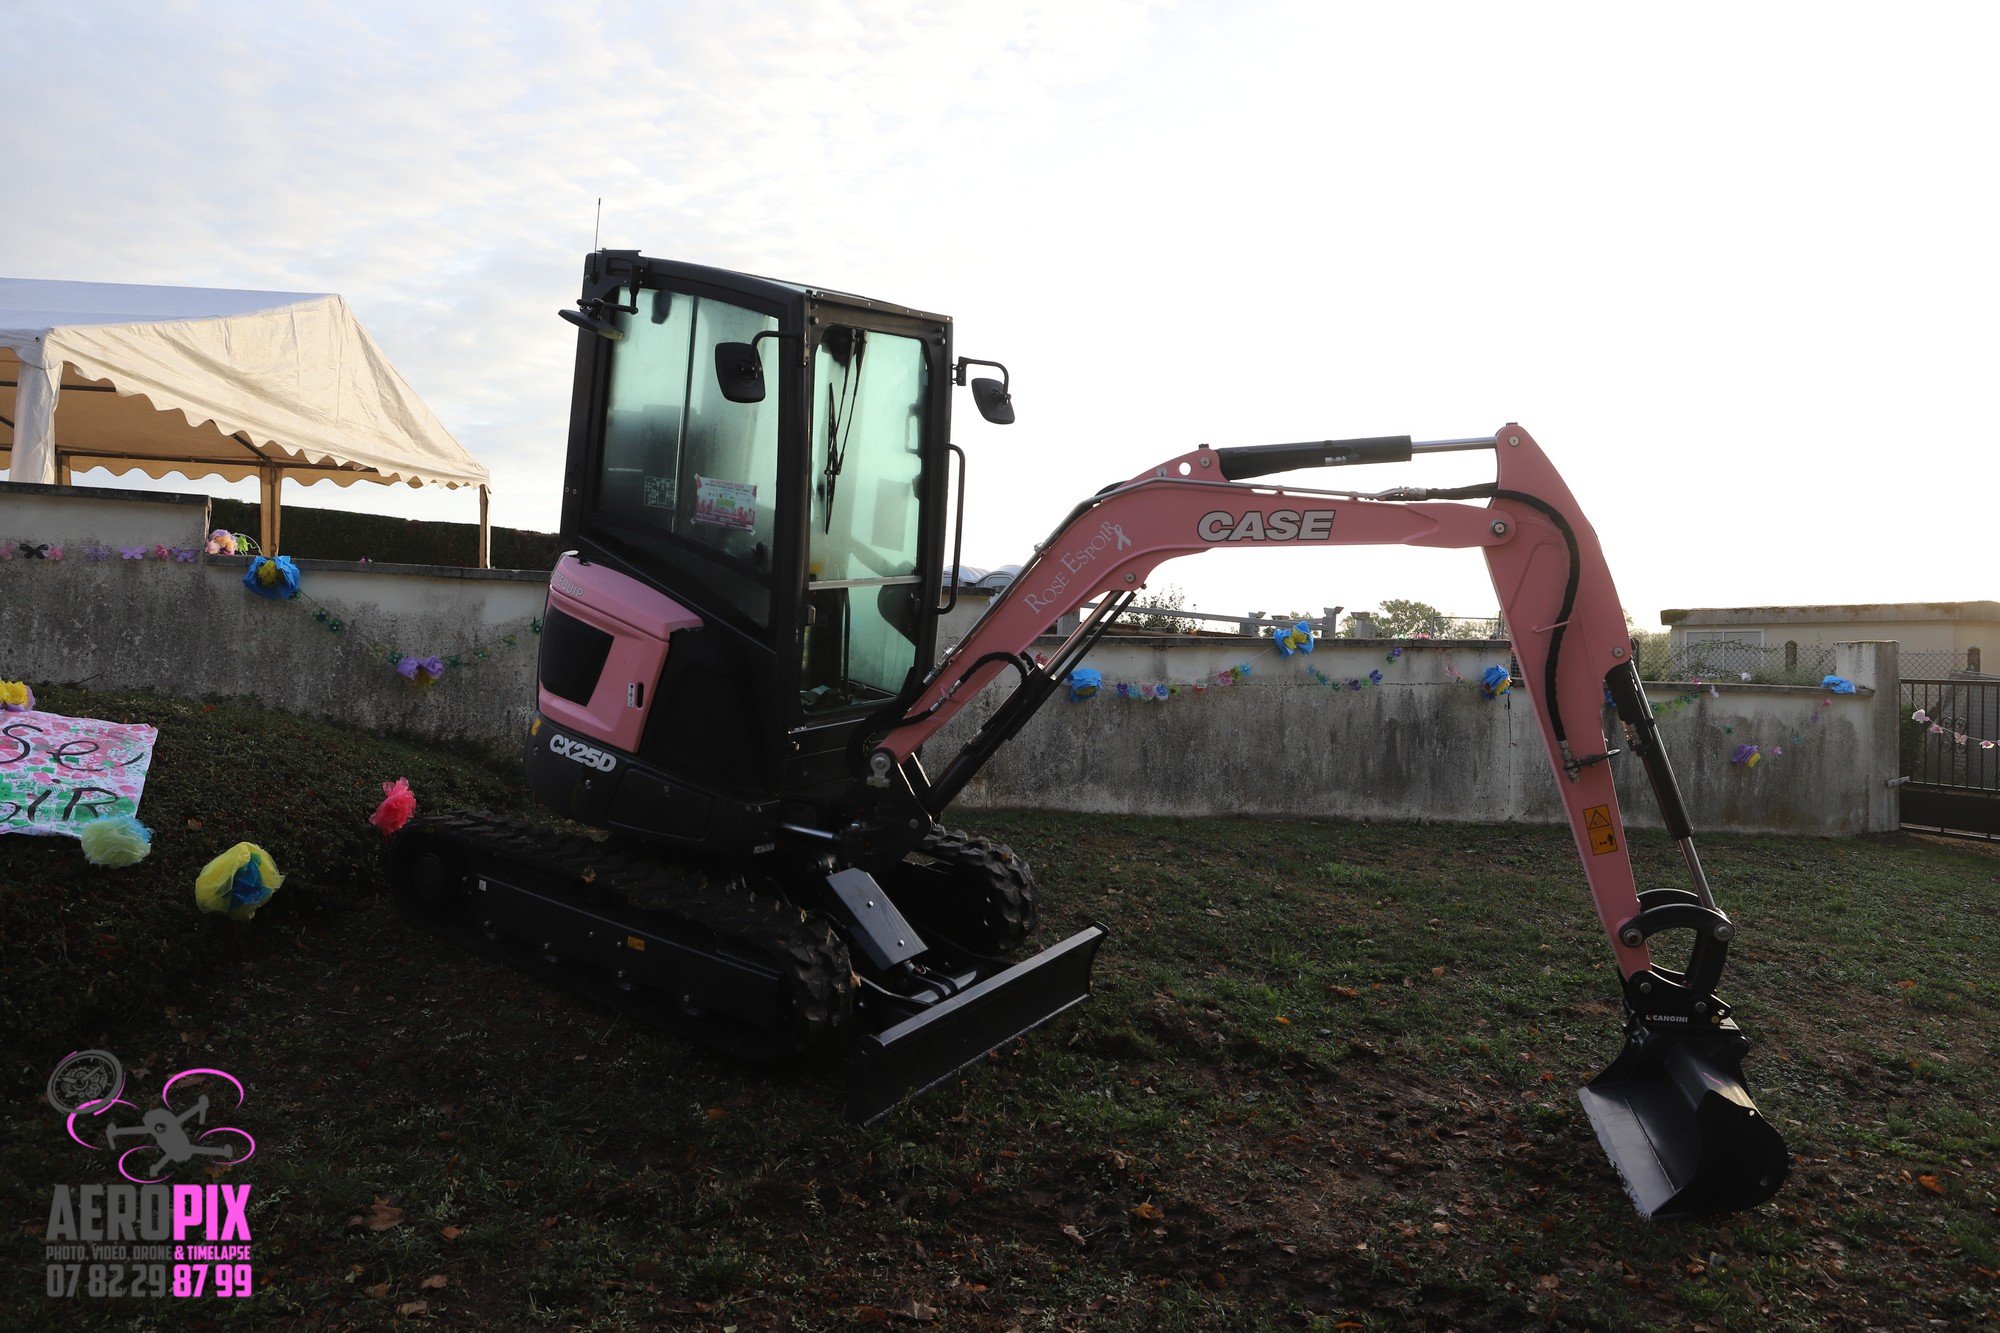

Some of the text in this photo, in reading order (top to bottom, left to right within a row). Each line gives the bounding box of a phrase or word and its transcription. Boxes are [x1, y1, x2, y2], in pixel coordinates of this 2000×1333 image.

[1197, 510, 1336, 541] CASE
[550, 734, 617, 772] CX25D
[1653, 1015, 1688, 1023] CANGINI
